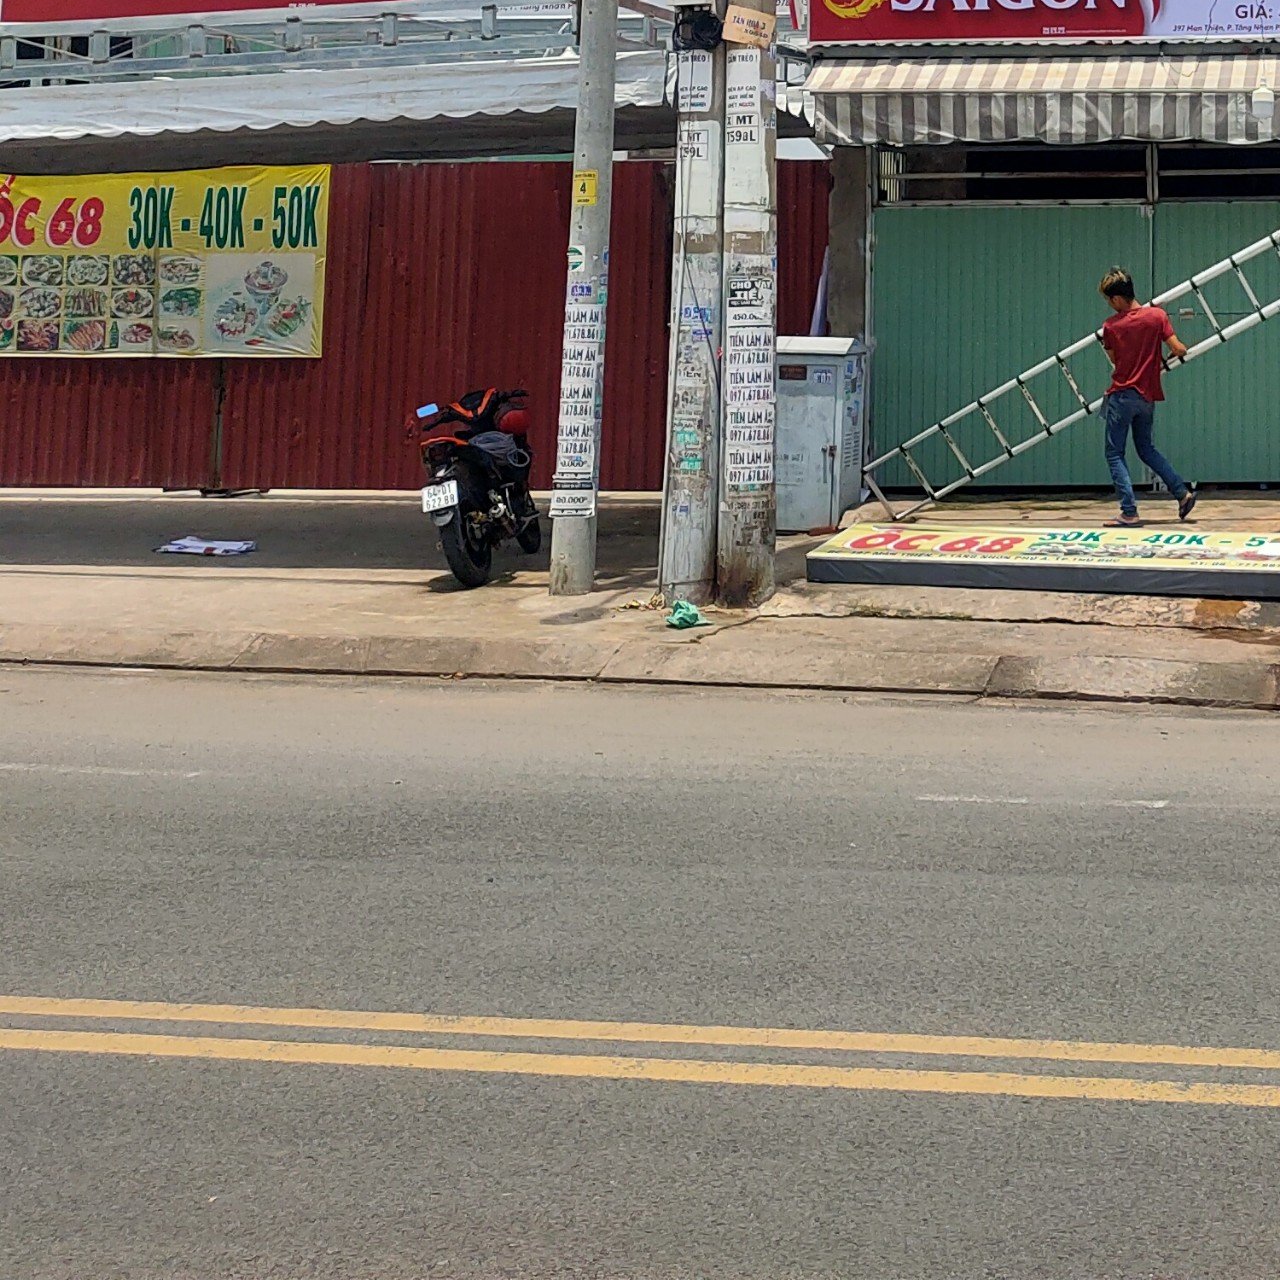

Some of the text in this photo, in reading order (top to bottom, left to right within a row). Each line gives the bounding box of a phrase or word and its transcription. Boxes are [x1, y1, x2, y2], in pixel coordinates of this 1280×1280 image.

[1235, 0, 1273, 20] GIÁ:
[49, 197, 105, 247] 68
[128, 186, 175, 249] 30K
[200, 186, 248, 249] 40K
[272, 185, 320, 248] 50K
[940, 535, 1025, 553] 68
[1141, 534, 1212, 547] 40K
